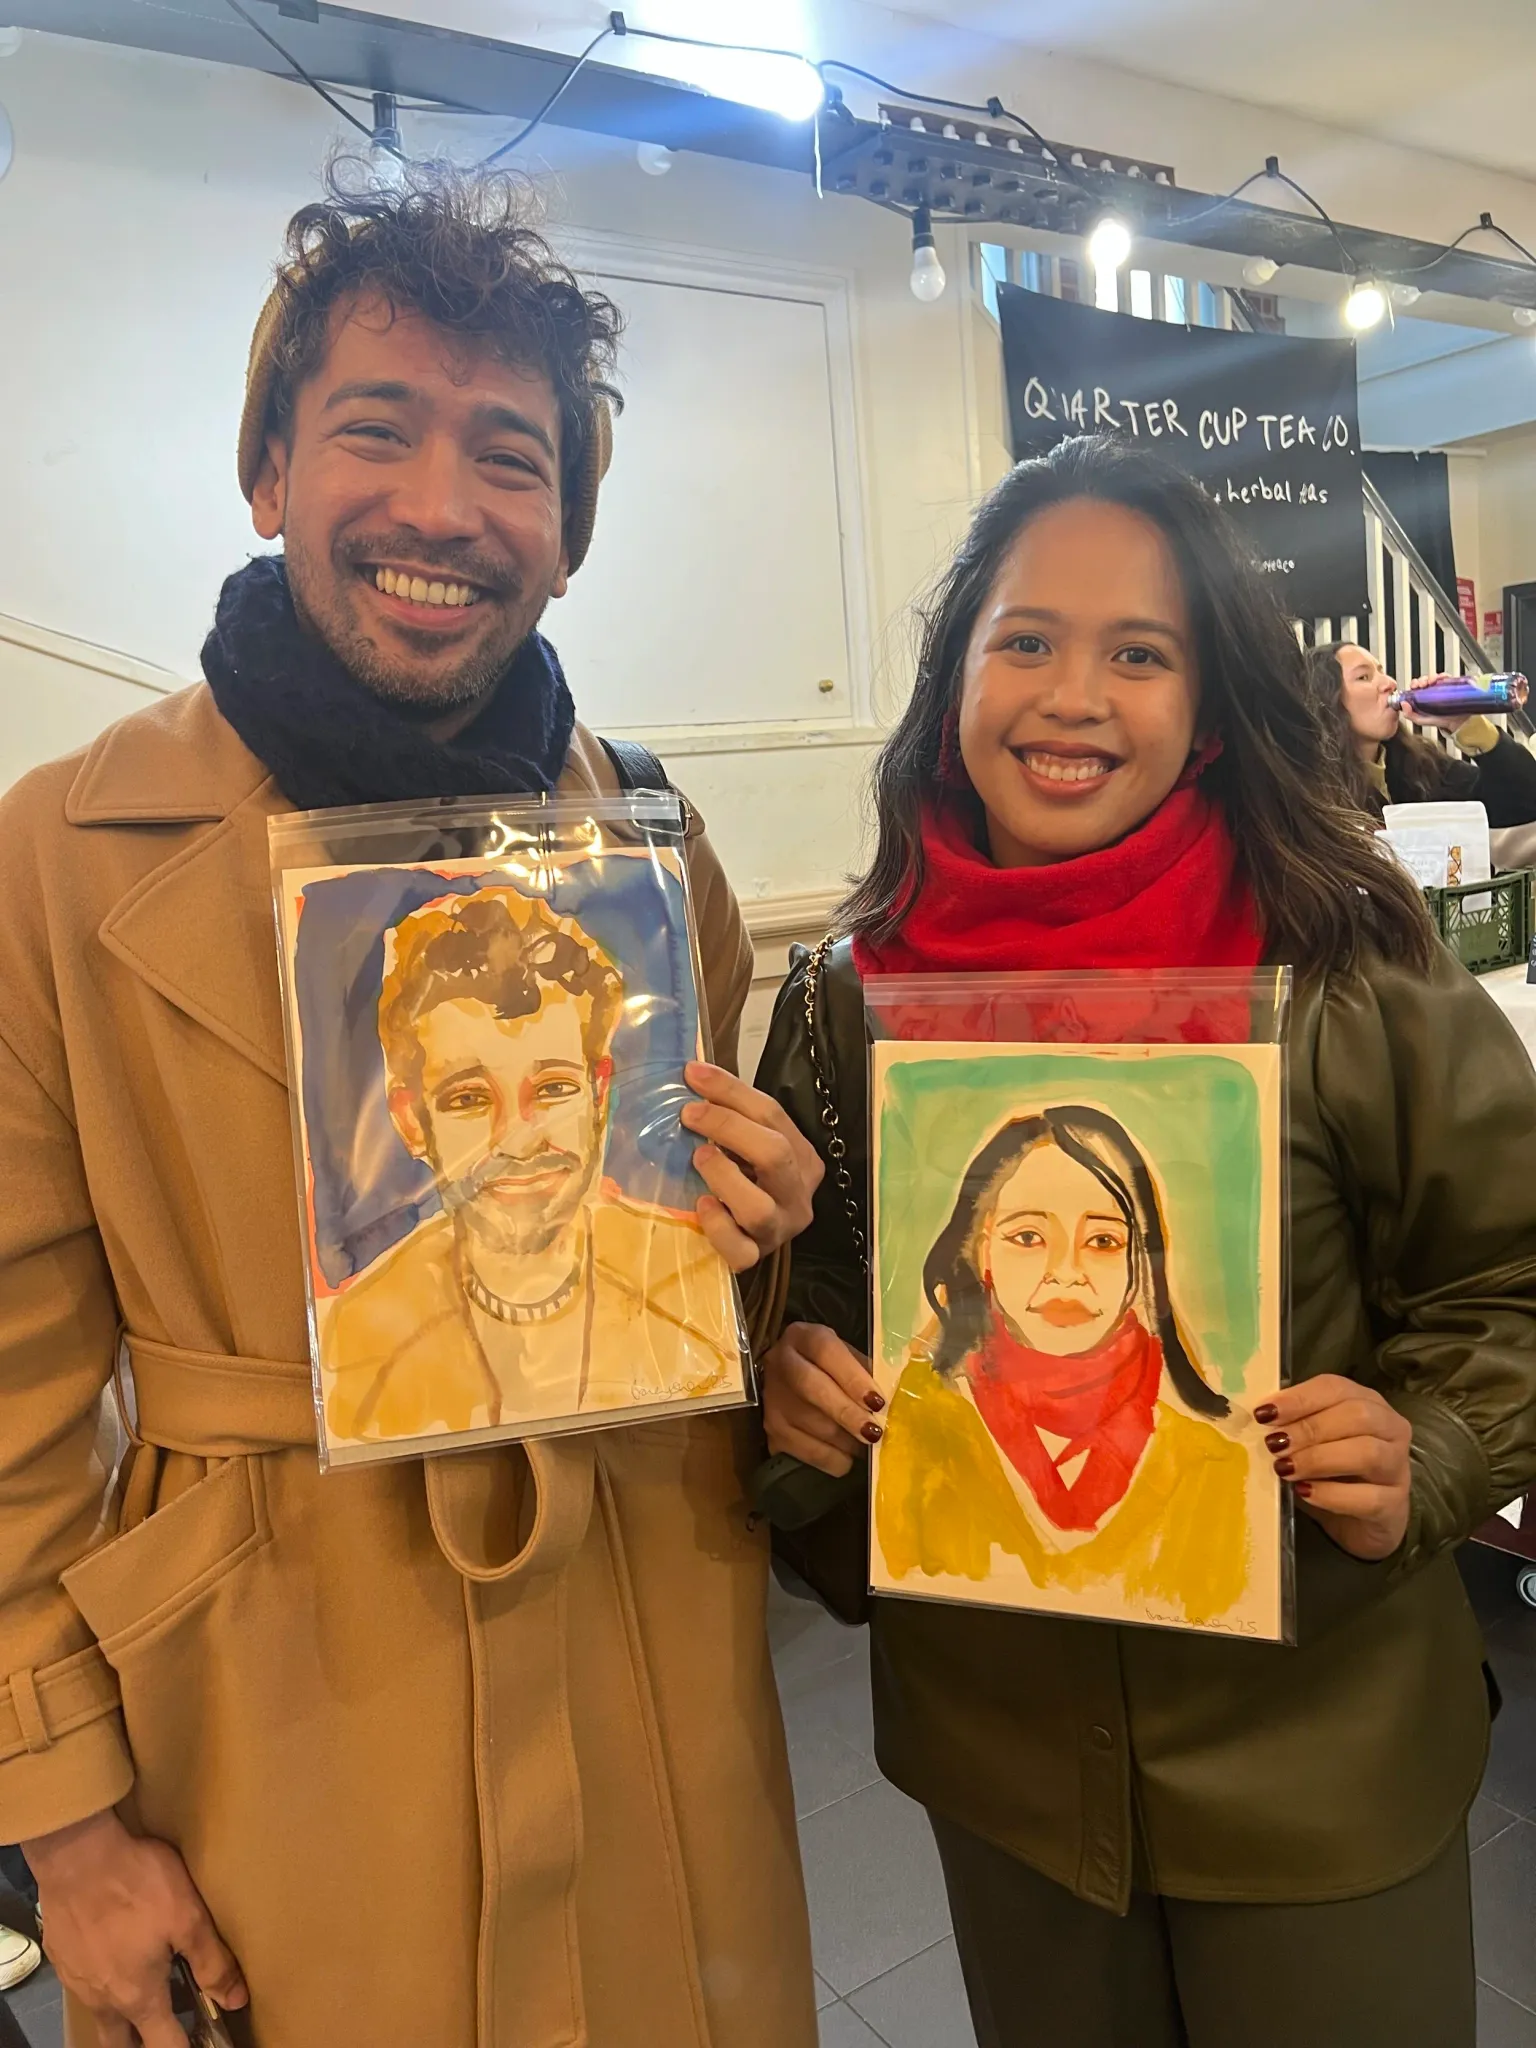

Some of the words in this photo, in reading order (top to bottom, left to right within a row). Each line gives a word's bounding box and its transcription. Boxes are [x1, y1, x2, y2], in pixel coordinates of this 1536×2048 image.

[1199, 407, 1247, 450] CUP
[1256, 414, 1316, 451] TEA
[1226, 476, 1291, 504] herbal
